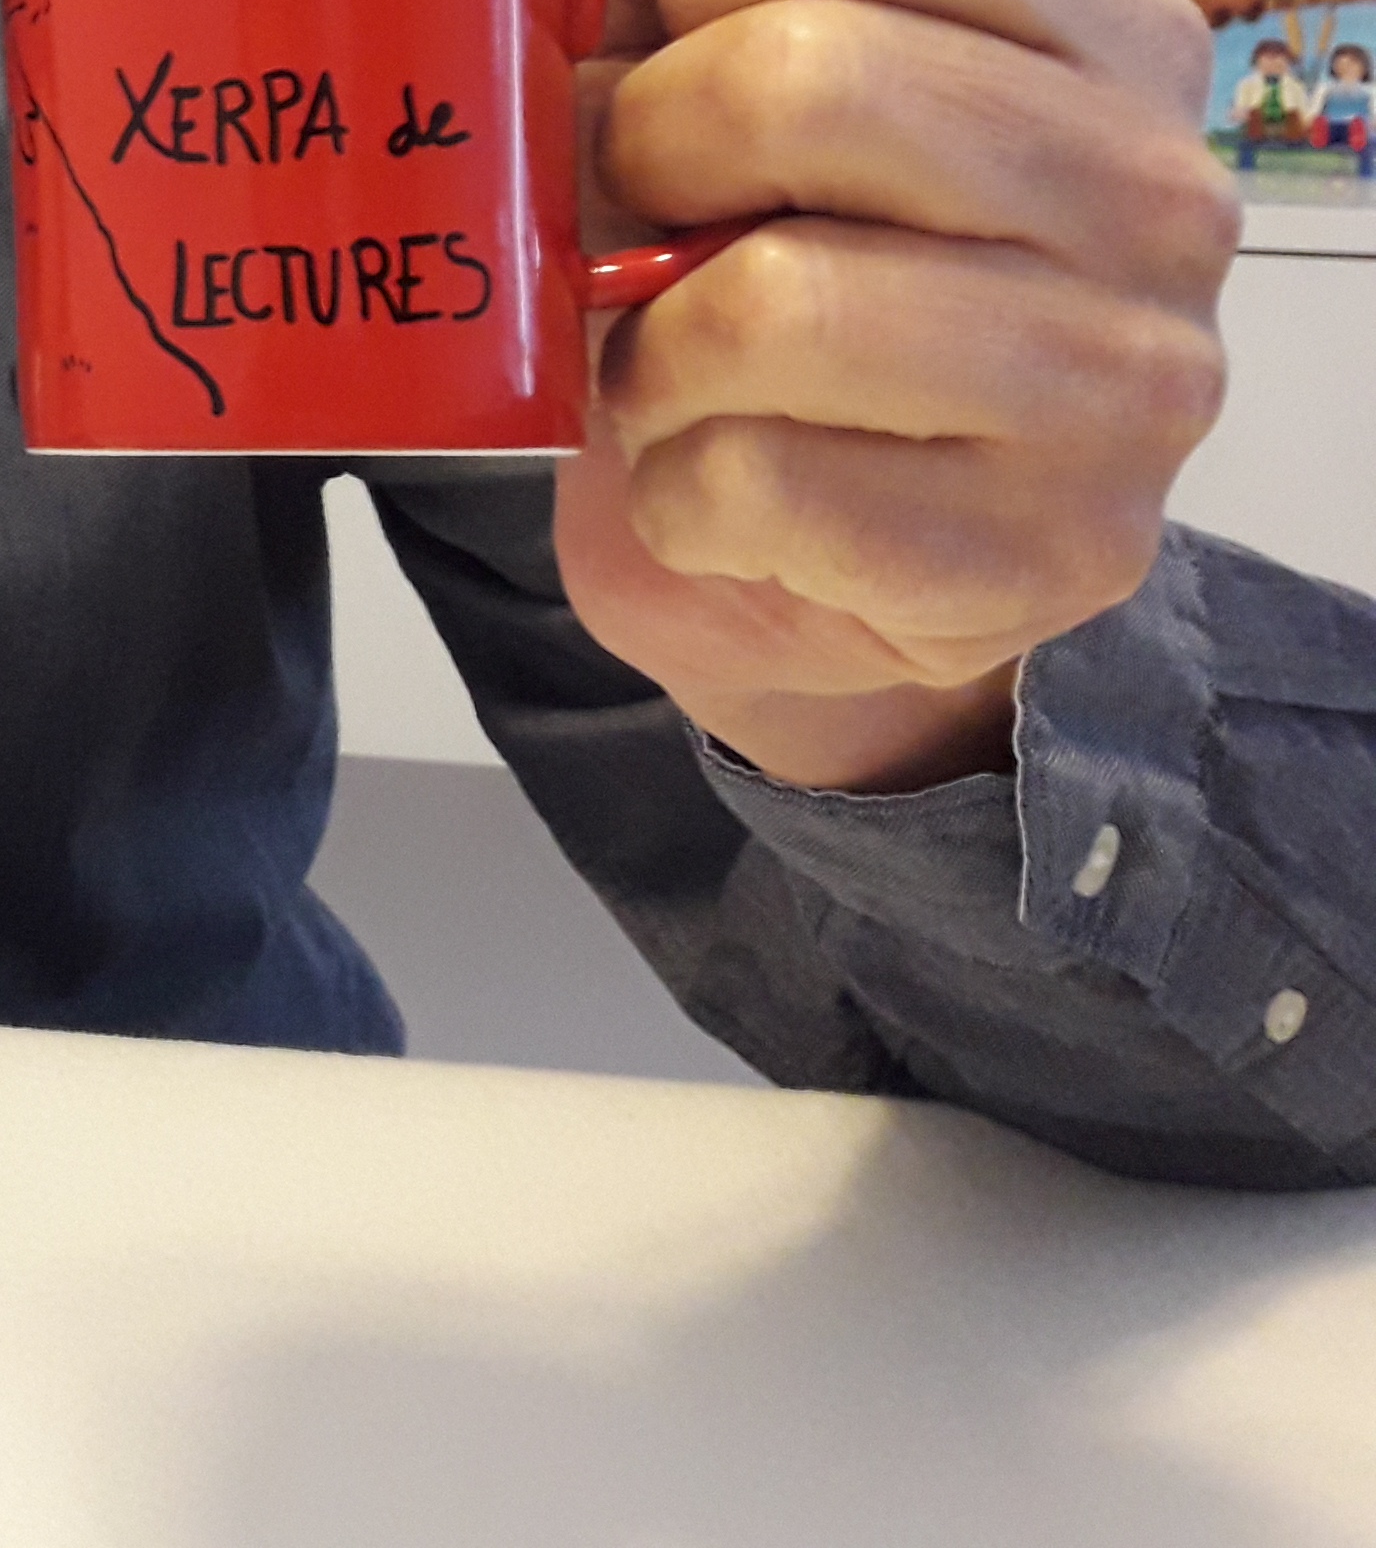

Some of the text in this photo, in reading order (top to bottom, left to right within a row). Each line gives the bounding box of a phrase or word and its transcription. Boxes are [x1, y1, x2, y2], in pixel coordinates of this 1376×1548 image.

[110, 51, 471, 165] XERPA de
[171, 231, 493, 329] LECTURES
